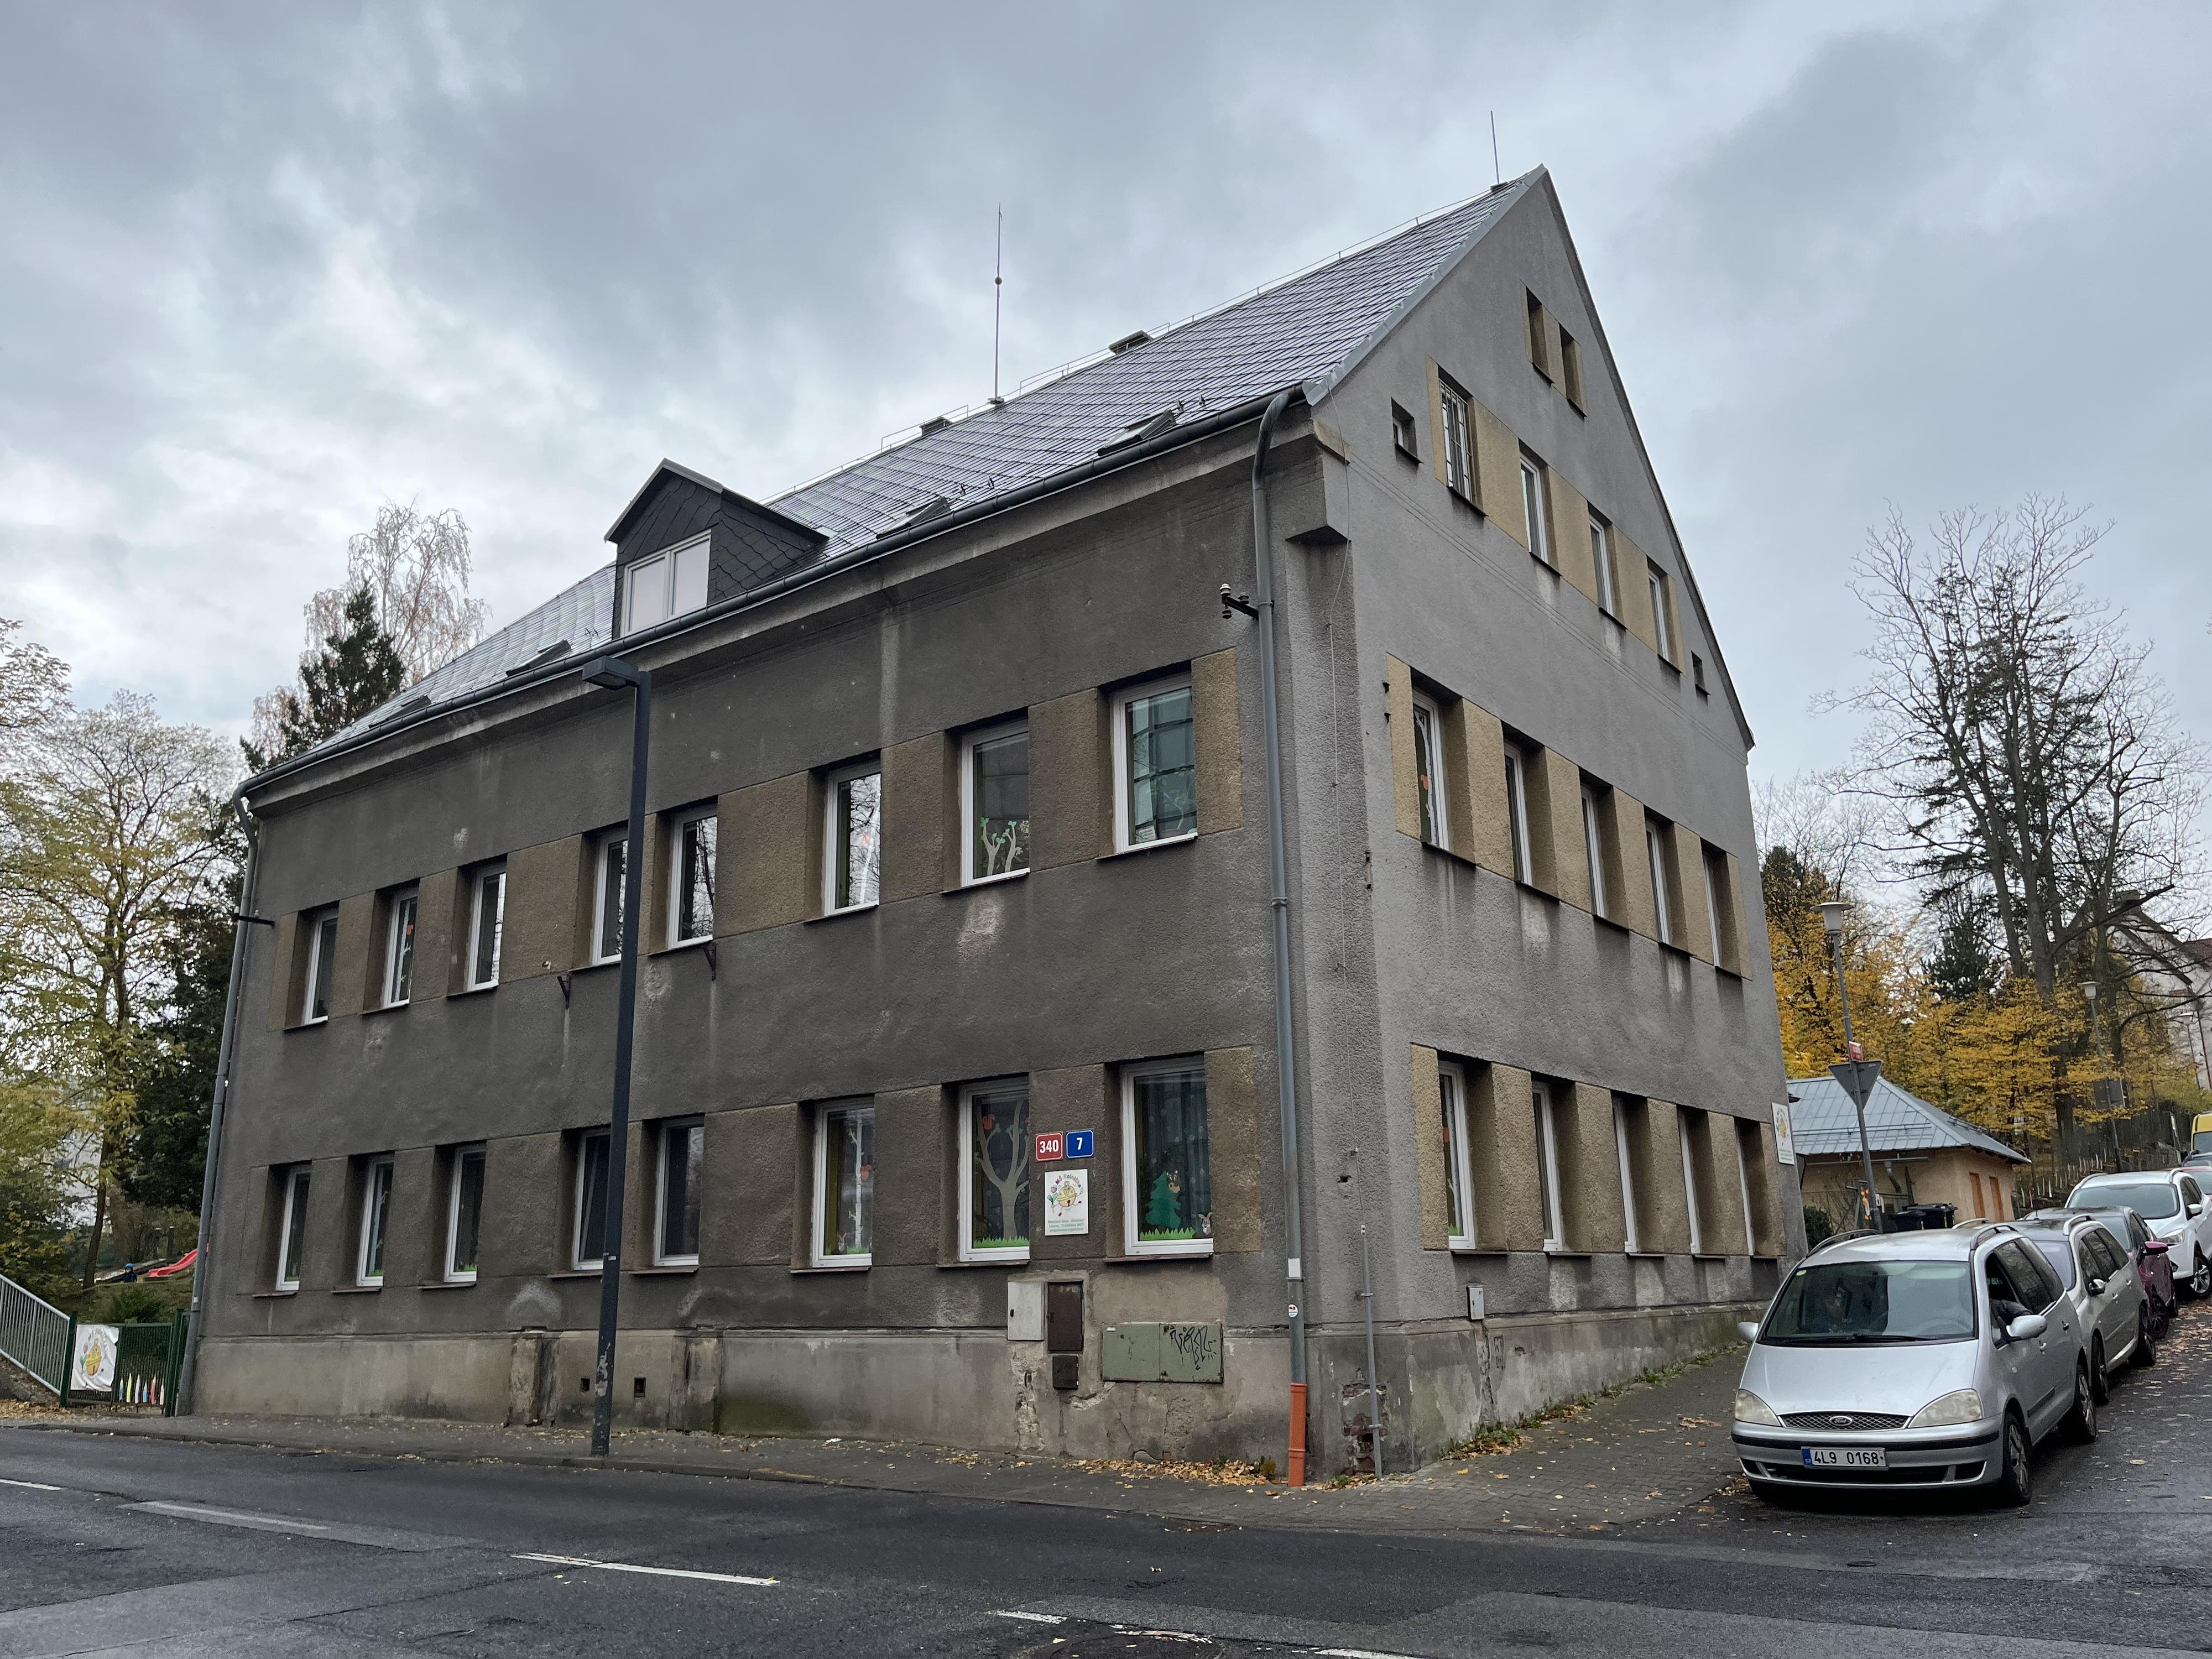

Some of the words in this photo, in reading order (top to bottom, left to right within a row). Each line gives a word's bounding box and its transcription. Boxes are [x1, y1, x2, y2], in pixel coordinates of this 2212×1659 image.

[1040, 1140, 1059, 1154] 340
[1076, 1137, 1083, 1150] 7
[1814, 1451, 1837, 1464] 4L9
[1846, 1452, 1879, 1464] 0168
